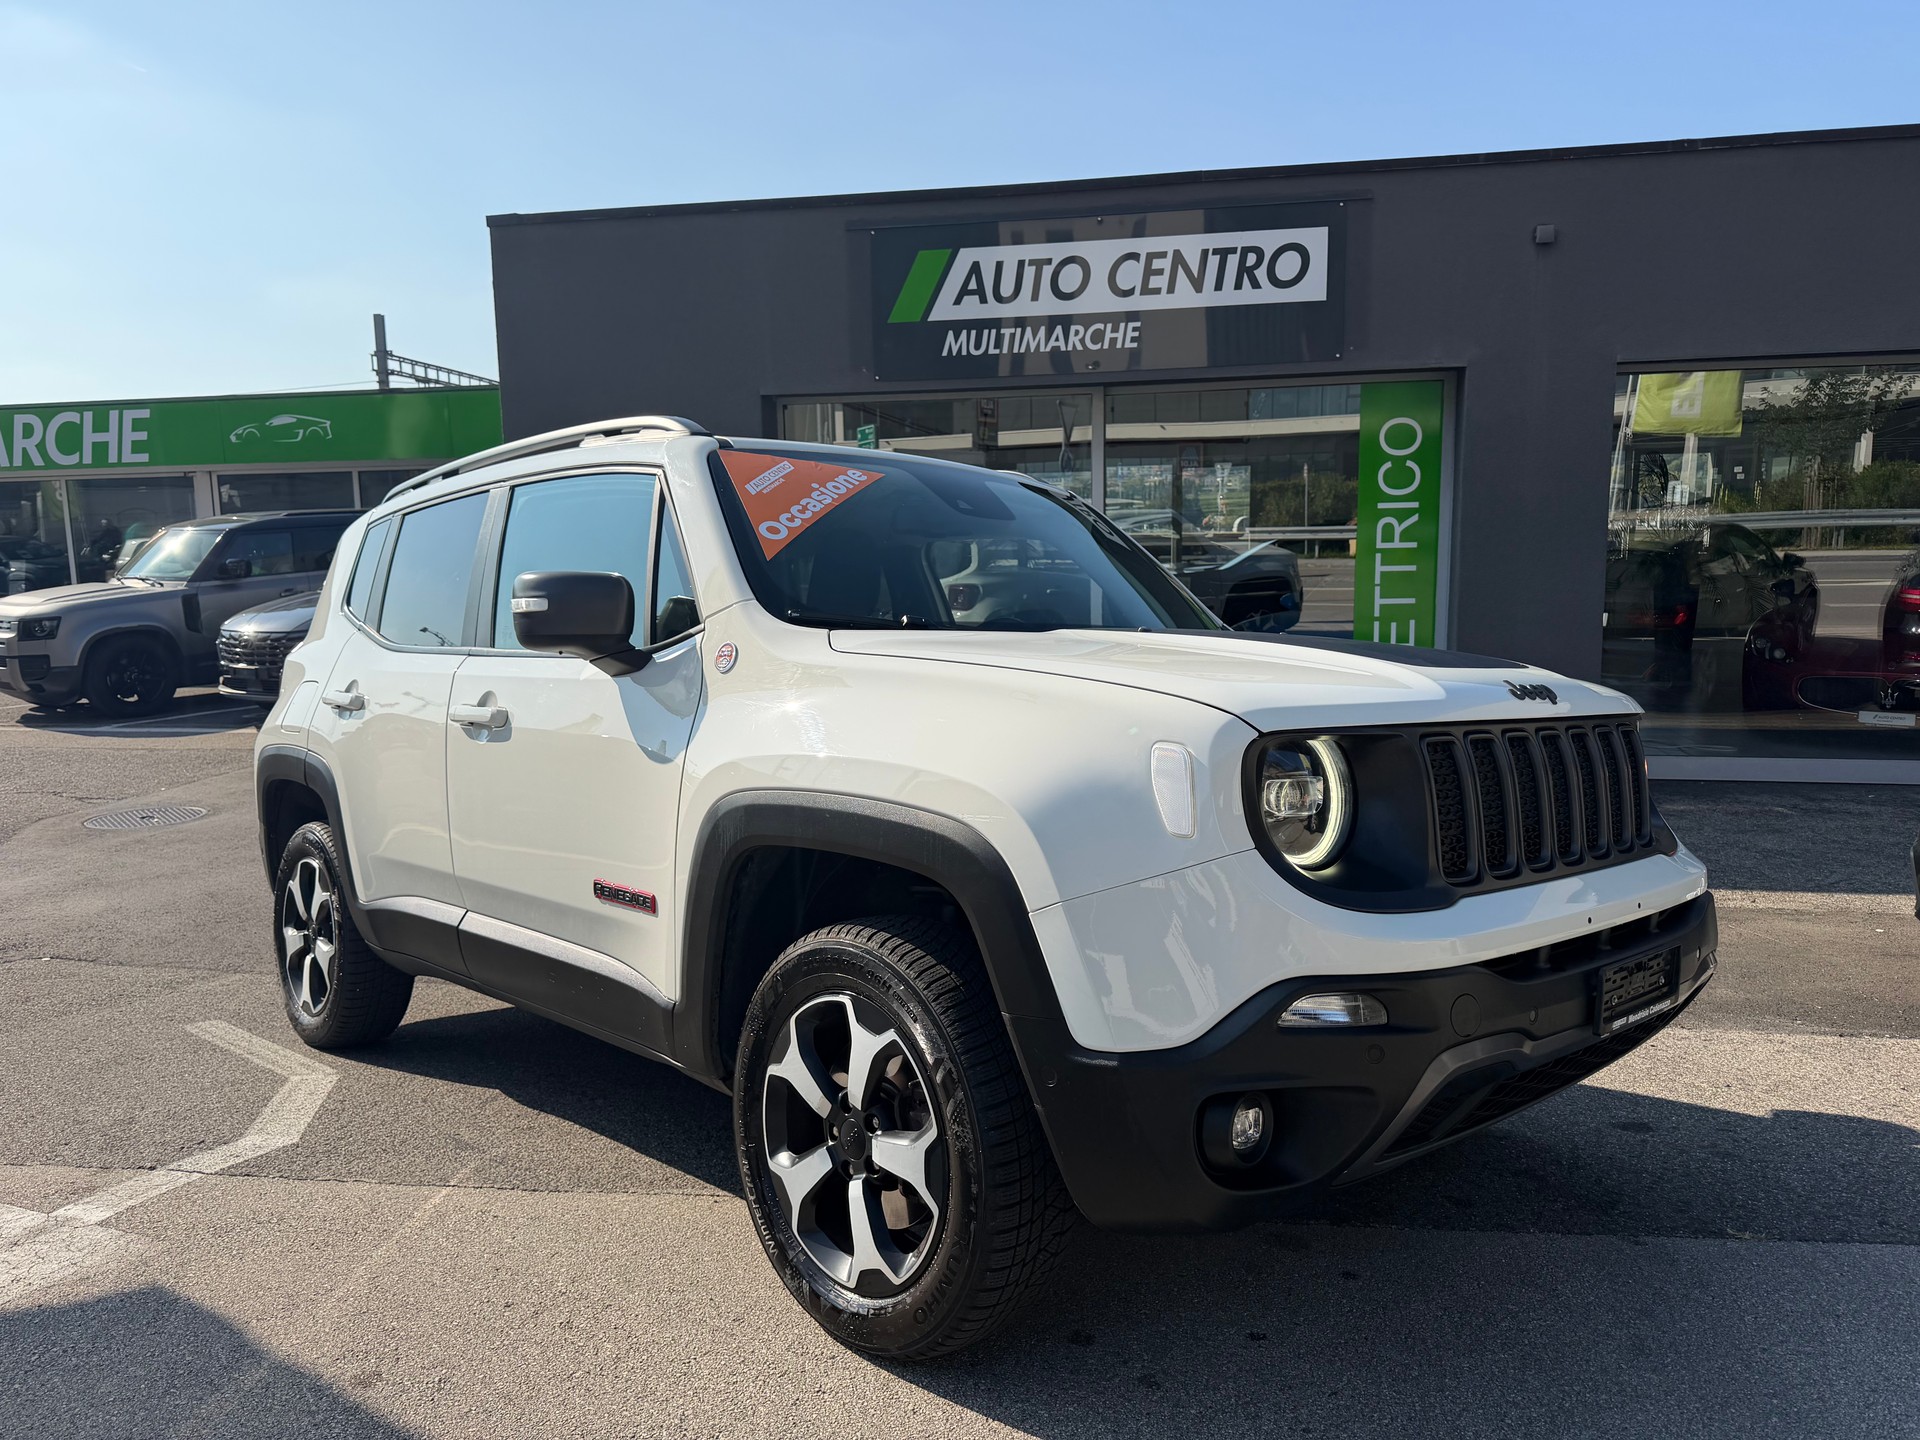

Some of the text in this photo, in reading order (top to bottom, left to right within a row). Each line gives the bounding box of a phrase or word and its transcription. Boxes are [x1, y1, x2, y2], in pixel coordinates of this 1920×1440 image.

[952, 241, 1311, 306] AUTO CENTRO
[941, 320, 1142, 357] MULTIMARCHE
[0, 408, 151, 468] RCHE
[758, 469, 868, 540] Occasione
[593, 882, 653, 911] RENEGADE
